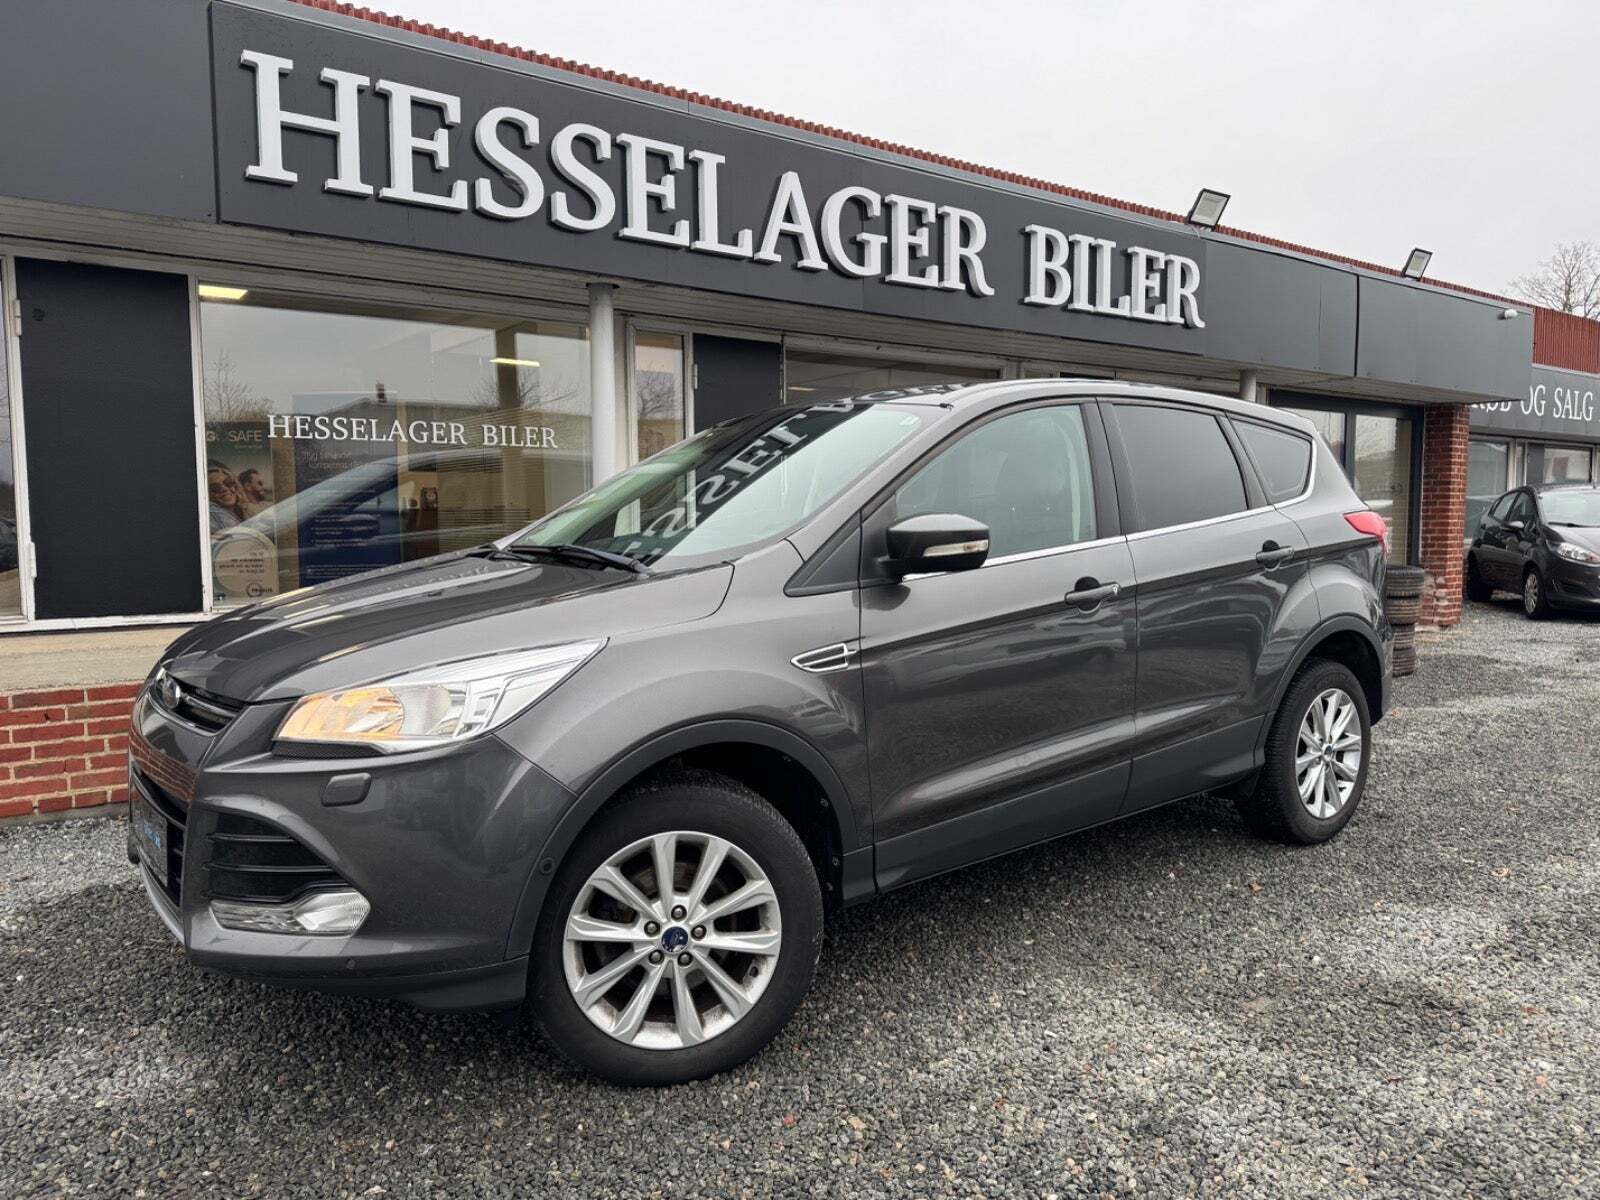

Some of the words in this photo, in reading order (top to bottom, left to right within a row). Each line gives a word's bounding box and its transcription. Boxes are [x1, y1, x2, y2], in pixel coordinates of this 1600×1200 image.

[240, 49, 995, 297] HESSELAGER
[1024, 223, 1206, 329] BILER
[1552, 387, 1595, 422] SALG
[227, 430, 263, 442] SAFE
[266, 414, 469, 446] HESSELAGER
[481, 424, 559, 449] BILER
